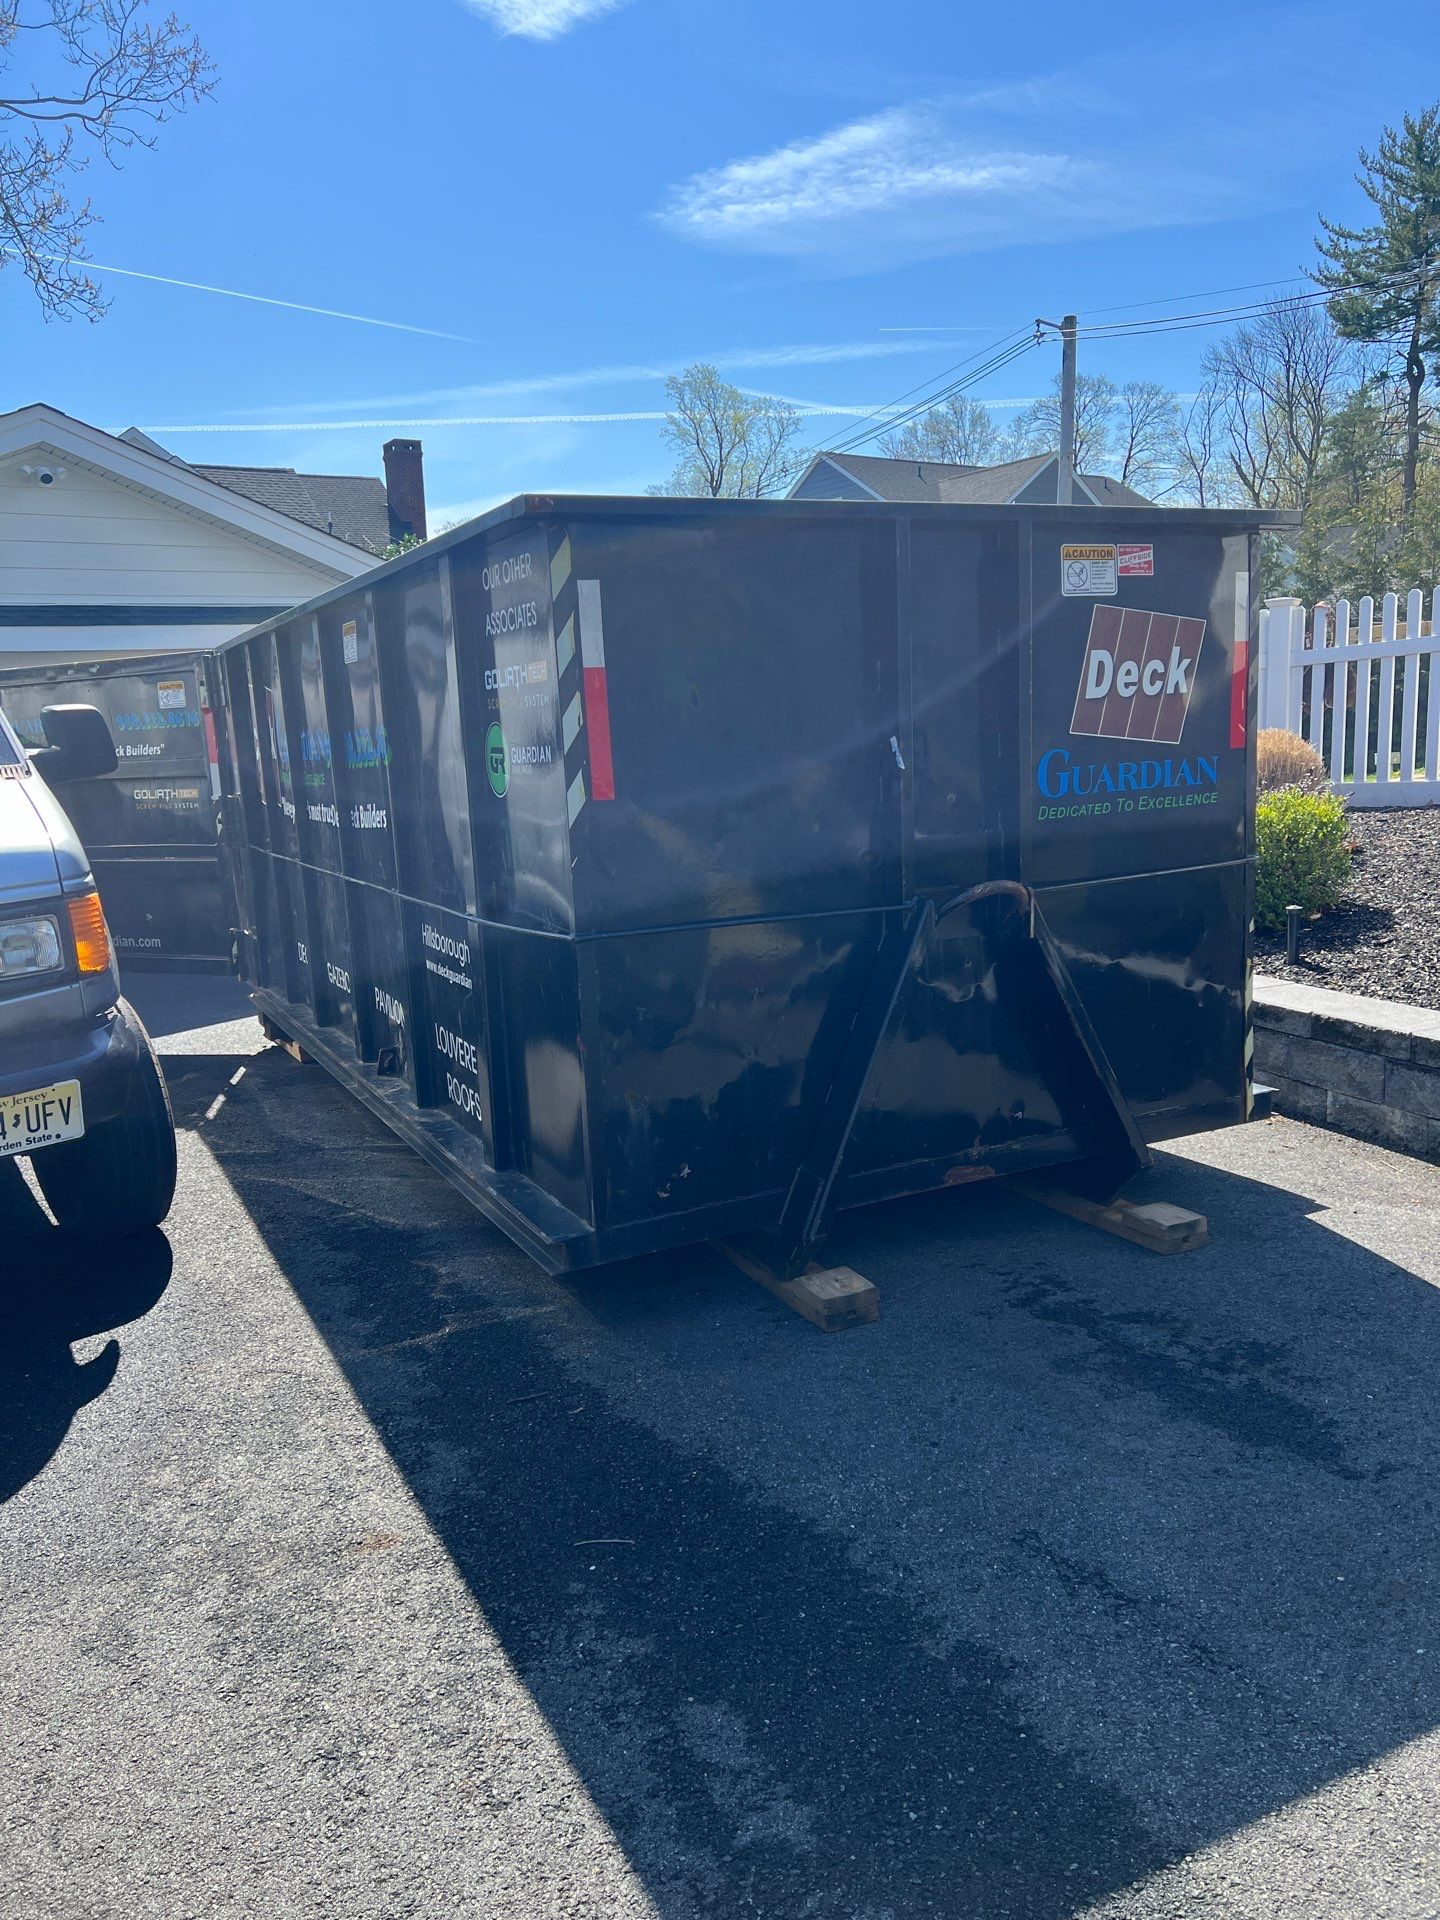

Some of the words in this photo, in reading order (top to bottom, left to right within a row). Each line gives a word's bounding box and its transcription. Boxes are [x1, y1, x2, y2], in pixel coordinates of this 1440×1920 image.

[1072, 549, 1113, 559] CAUTION
[1120, 552, 1152, 565] CLIFFSIDE
[482, 567, 501, 591] OUR
[502, 552, 532, 585] OTHER
[485, 601, 537, 637] ASSOCIATES
[1085, 646, 1192, 700] Deck
[524, 695, 549, 707] SYSTEM
[115, 745, 125, 757] ck
[511, 745, 552, 763] GUARDIAN
[359, 803, 387, 829] Builders
[1038, 799, 1111, 820] DEDICATED
[1138, 792, 1219, 811] EXCELLENCE
[112, 935, 161, 948] dian.com
[422, 923, 471, 967] Hillsborough
[327, 962, 351, 994] GAZEBO
[374, 987, 406, 1028] PAVILION
[435, 1022, 478, 1075] LOUVERE
[11, 1092, 48, 1108] Jersey
[446, 1072, 483, 1122] ROOFS
[25, 1096, 72, 1134] UFV
[0, 1141, 22, 1152] rden
[25, 1133, 53, 1146] State
